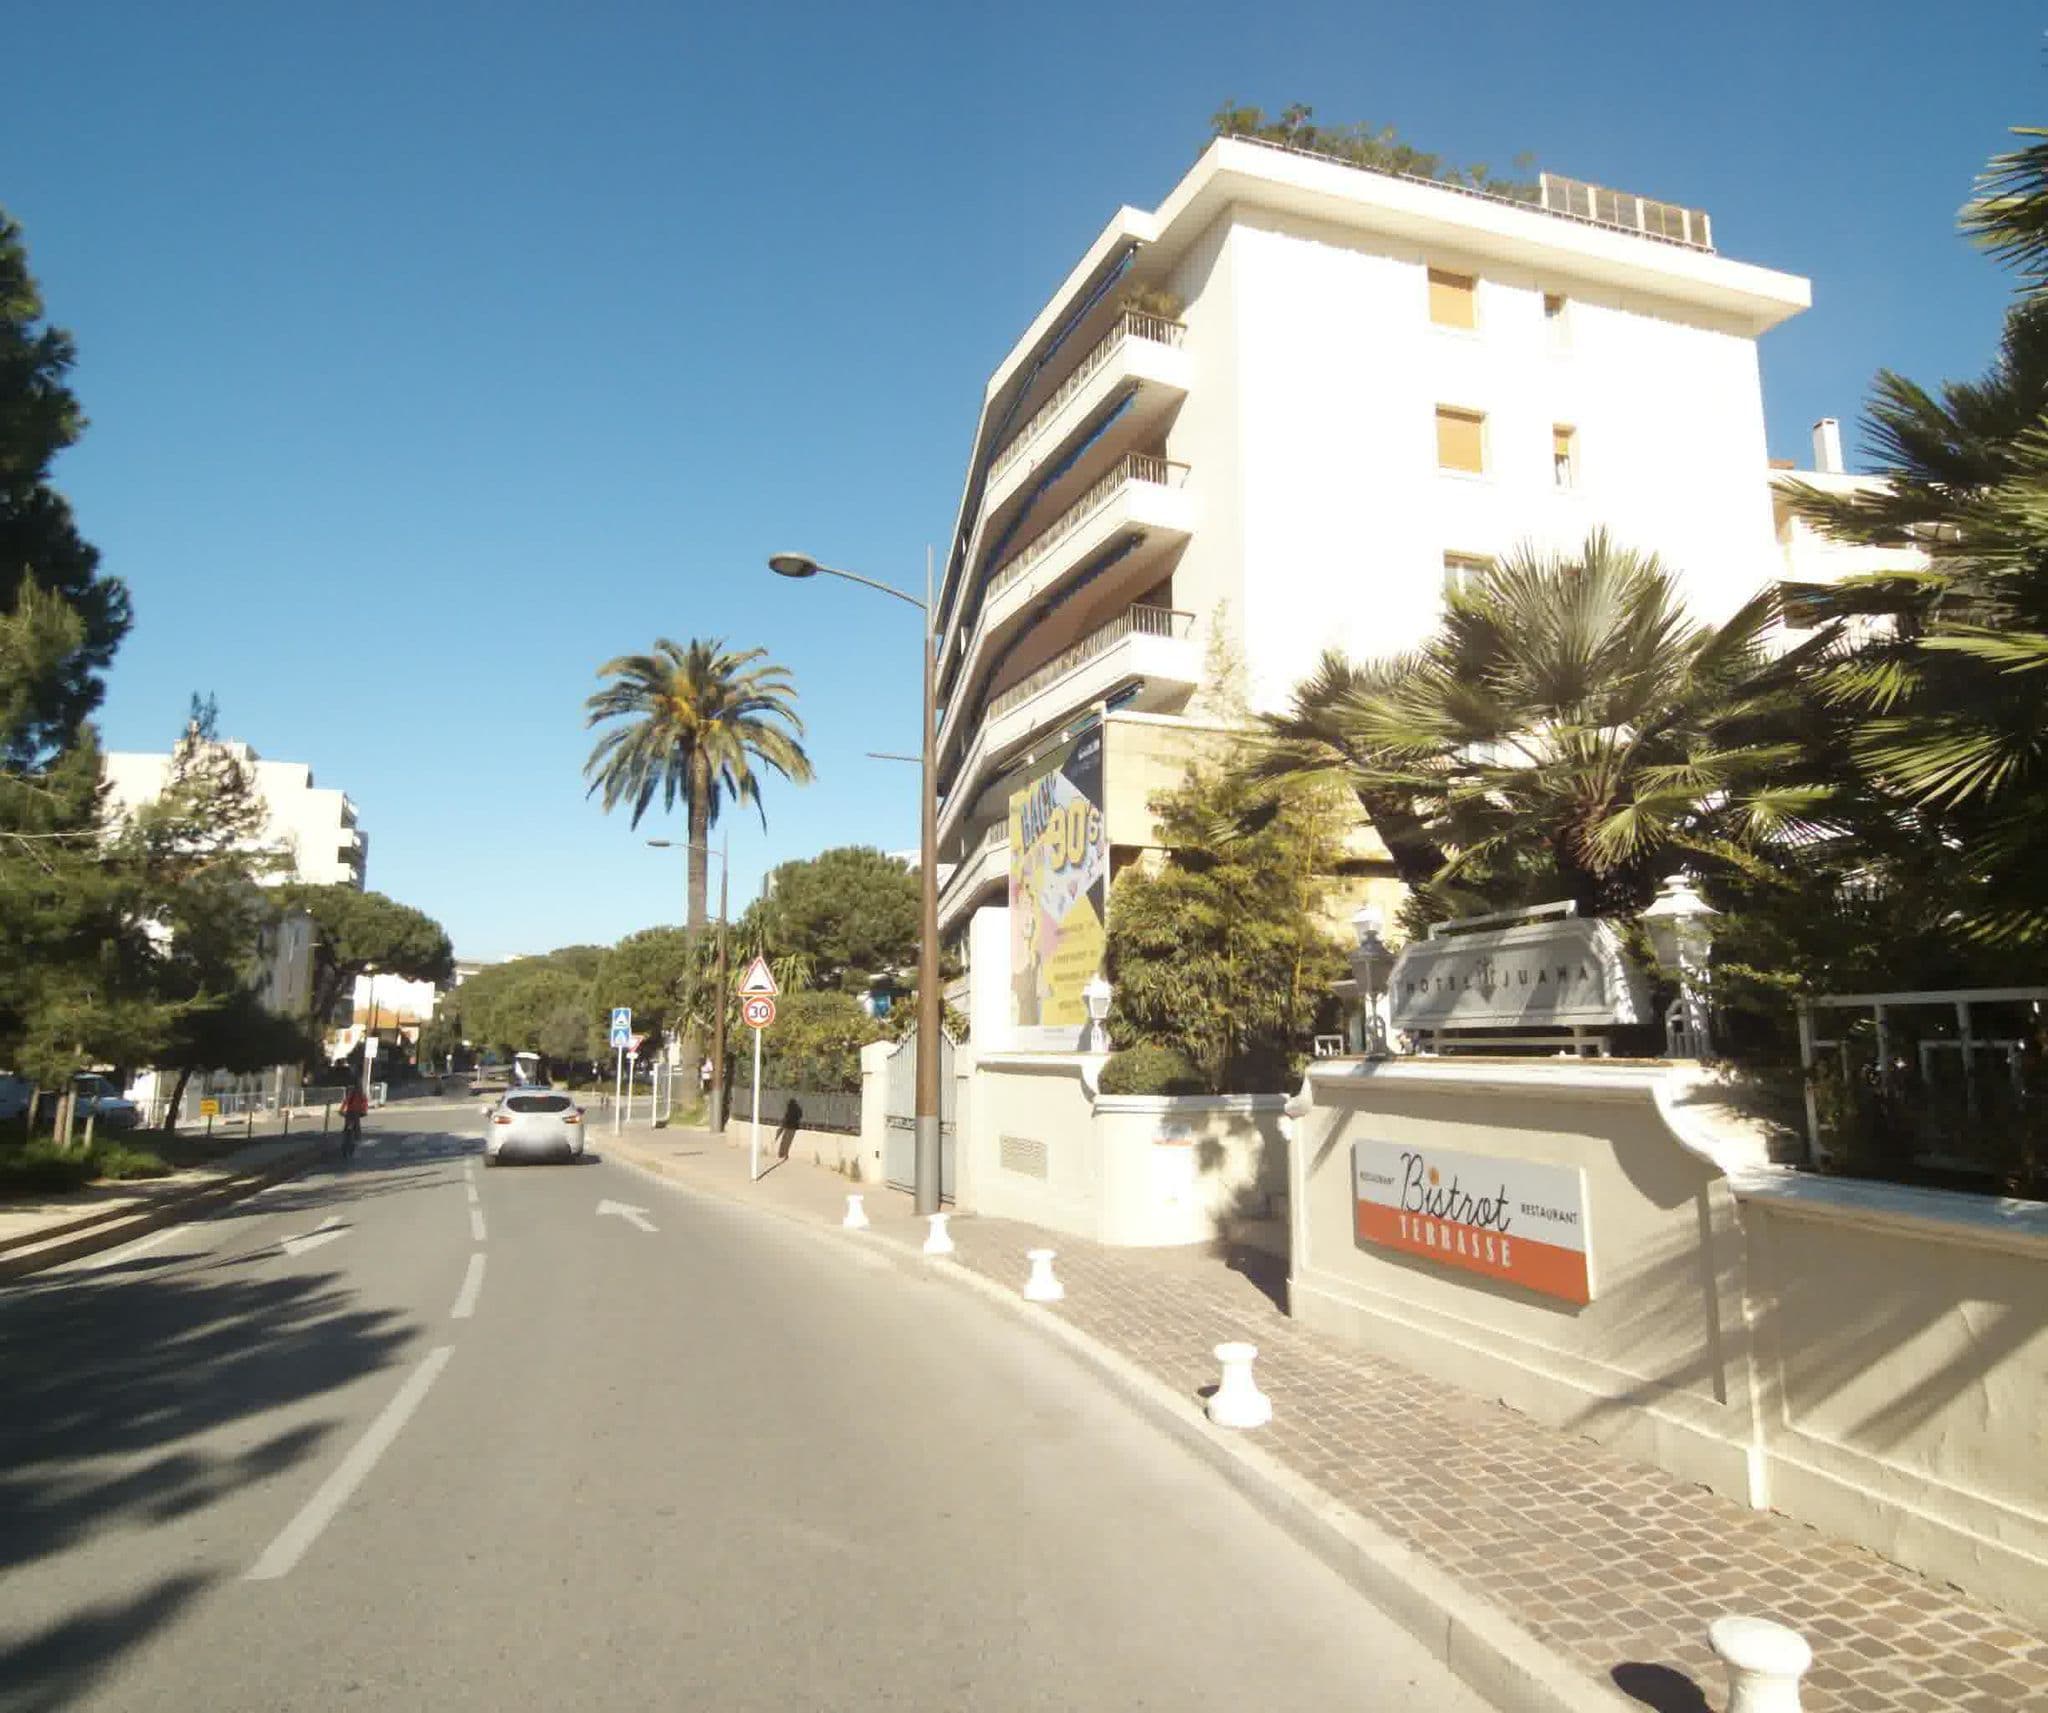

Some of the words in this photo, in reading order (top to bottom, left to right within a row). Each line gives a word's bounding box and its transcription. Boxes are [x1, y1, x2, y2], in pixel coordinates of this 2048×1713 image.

[749, 1005, 769, 1019] 30
[1400, 1152, 1512, 1232] Bistrot
[1520, 1203, 1578, 1225] RESTAURANT
[1399, 1214, 1513, 1268] TERRASSE
